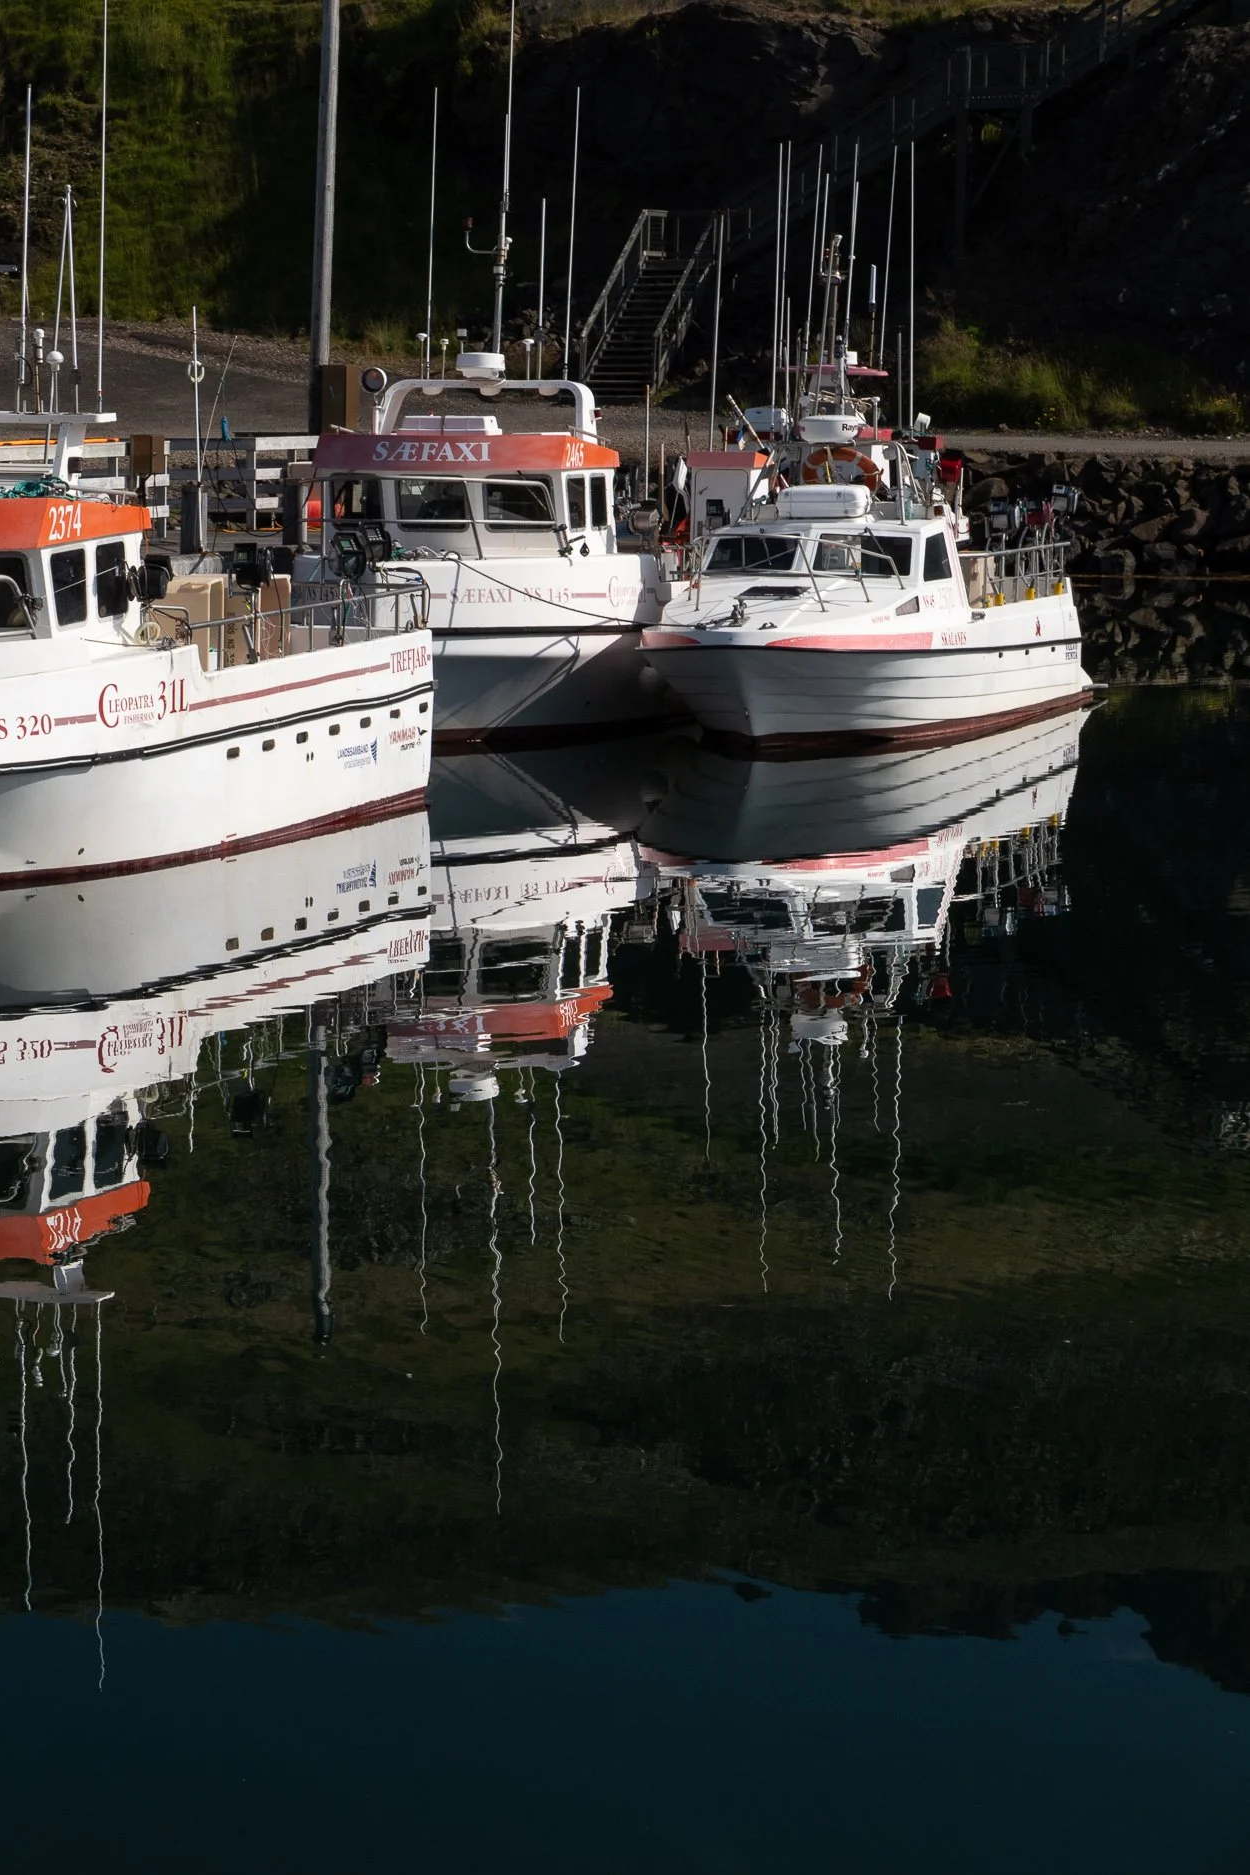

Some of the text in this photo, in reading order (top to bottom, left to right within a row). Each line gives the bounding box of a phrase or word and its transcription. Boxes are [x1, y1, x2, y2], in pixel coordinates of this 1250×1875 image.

[372, 441, 491, 462] SÆFAXI
[565, 442, 585, 468] 2465
[48, 502, 82, 541] 2374
[449, 587, 570, 605] SÆFAXI NS 145
[390, 646, 428, 675] TREFJAR
[98, 678, 189, 728] CLEOPATRA 31L
[16, 714, 53, 740] 320
[389, 726, 416, 745] YANMAR
